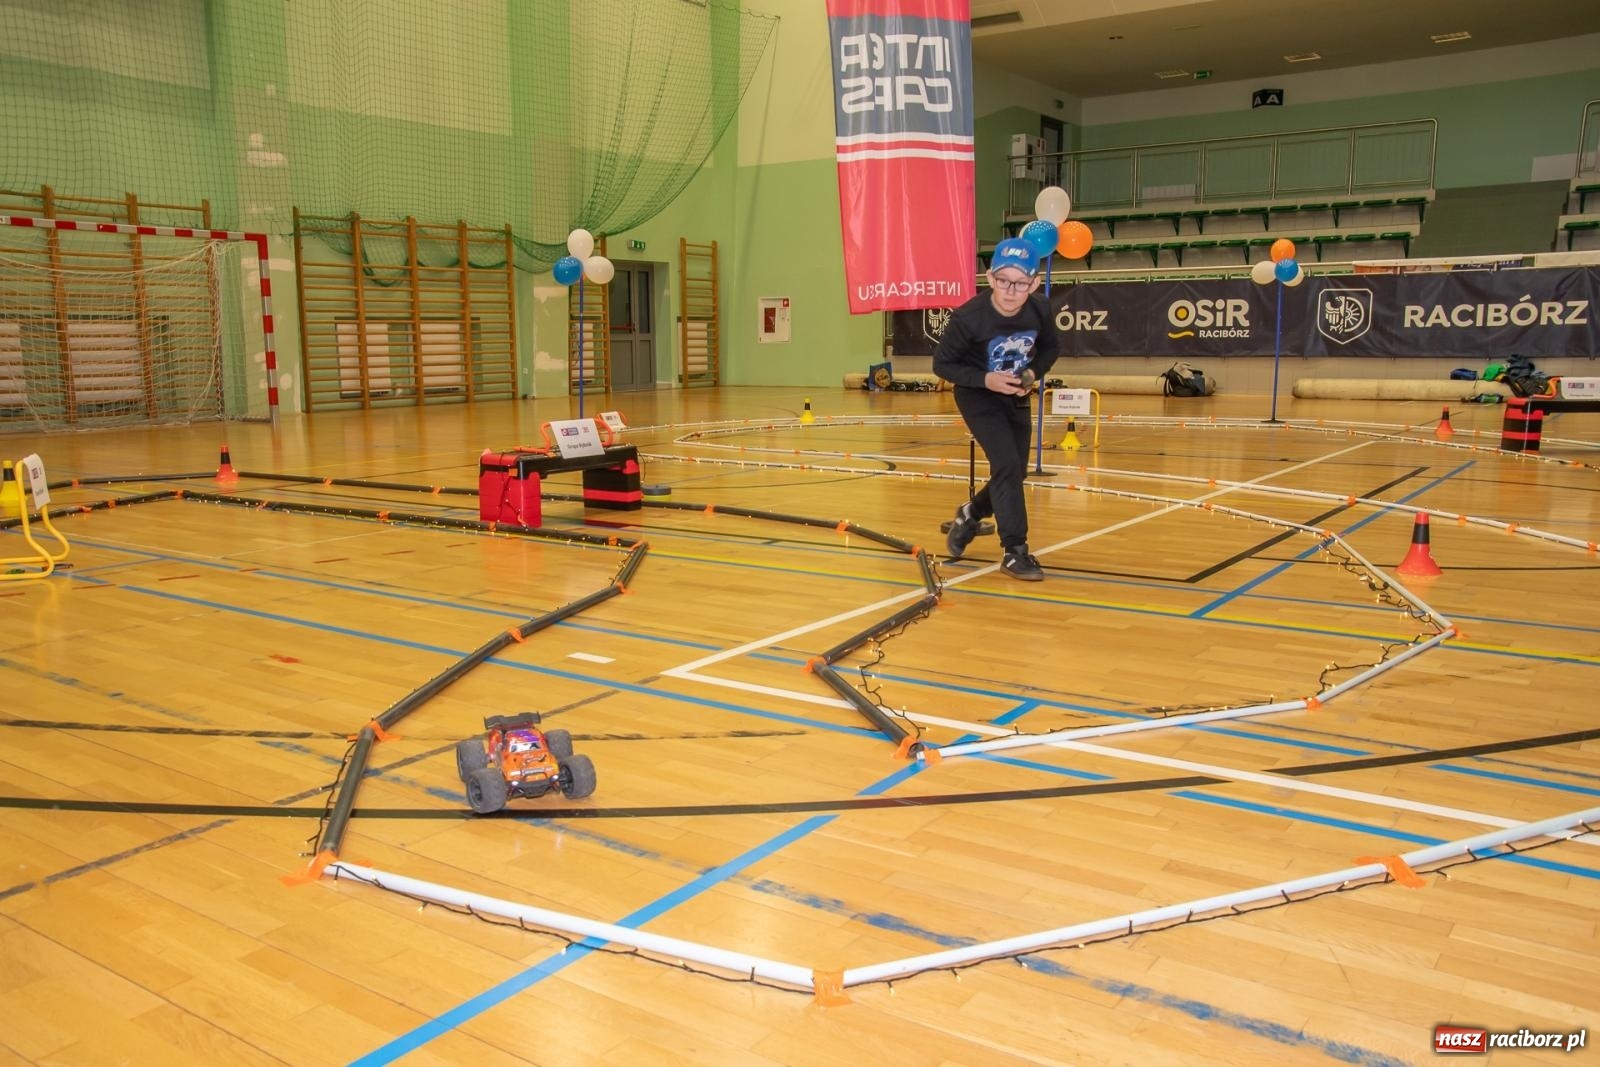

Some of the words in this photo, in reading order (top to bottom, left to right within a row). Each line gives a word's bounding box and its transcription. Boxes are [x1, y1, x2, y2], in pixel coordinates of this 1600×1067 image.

[1266, 94, 1280, 104] A
[1055, 304, 1109, 331] ÓRZ
[1404, 294, 1589, 328] RACIBÓRZ
[1199, 328, 1250, 338] RACIBÓRZ
